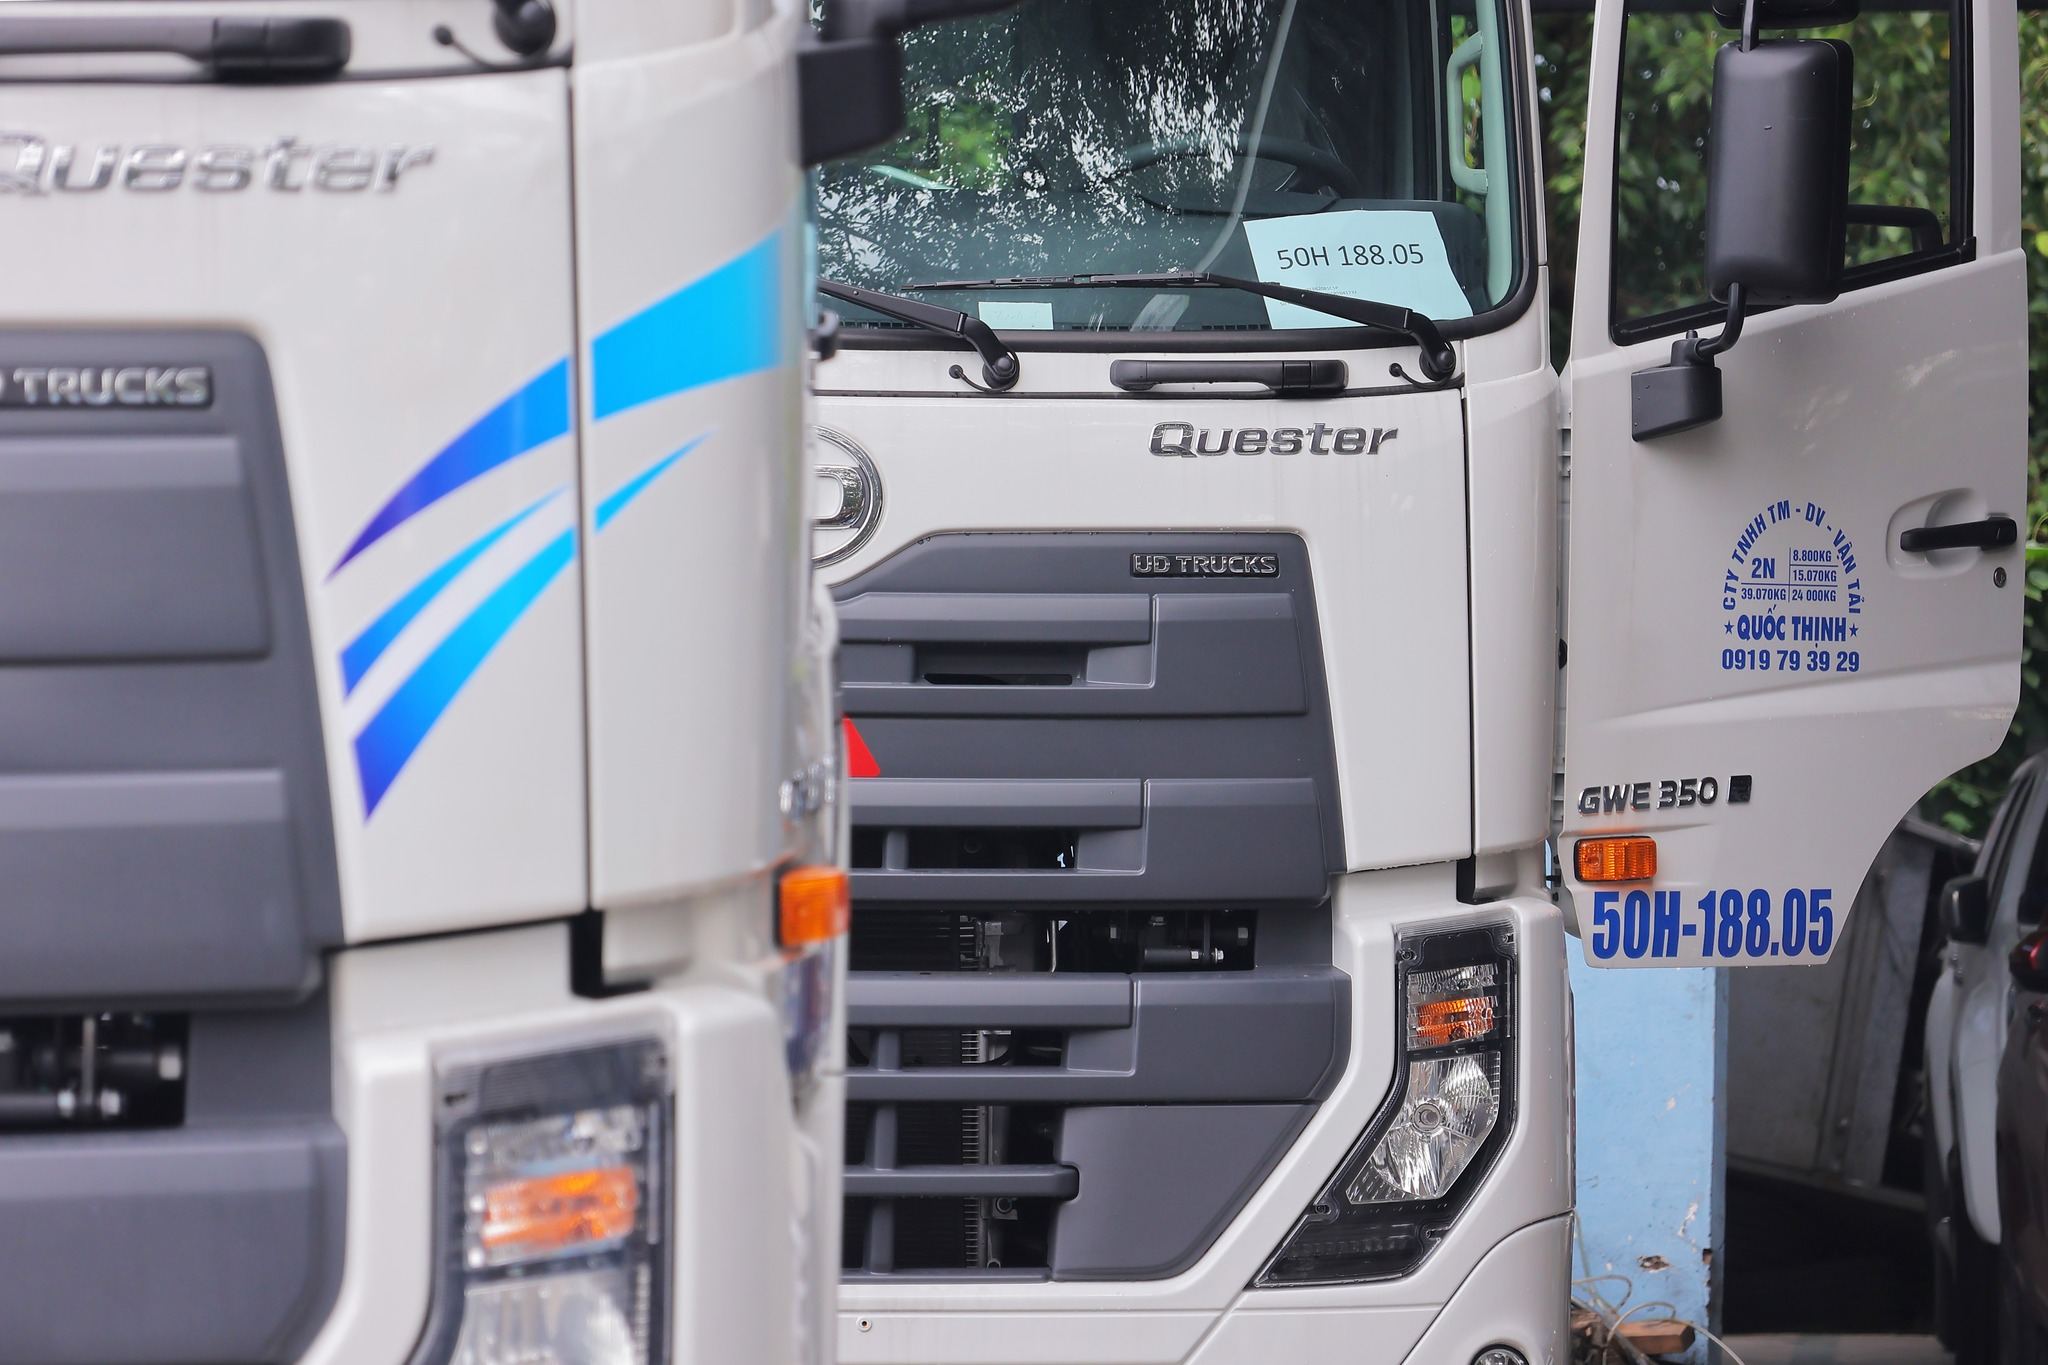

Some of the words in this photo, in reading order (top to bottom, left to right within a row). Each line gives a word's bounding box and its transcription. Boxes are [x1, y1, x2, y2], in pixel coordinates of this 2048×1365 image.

[1277, 246, 1330, 270] 50H
[1338, 243, 1425, 267] 188.05
[13, 367, 208, 404] TRUCKS
[1148, 421, 1399, 458] Quester
[1133, 553, 1171, 574] UD
[1175, 555, 1277, 575] TRUCKS
[1722, 568, 1740, 611] CTY
[1731, 513, 1767, 564] TNHH
[1767, 500, 1791, 524] TM
[1805, 502, 1826, 527] DV
[1833, 529, 1857, 575] VẬN
[1751, 557, 1776, 579] 2N
[1793, 550, 1832, 562] 8.800KG
[1793, 570, 1837, 582] 15.070KG
[1741, 588, 1787, 600] 39.070KG
[1737, 604, 1786, 642] QUỐC
[1791, 616, 1847, 648] THỊNH
[1722, 648, 1771, 670] 0919
[1776, 650, 1800, 671] 79
[1806, 651, 1831, 672] 39
[1836, 651, 1860, 672] 29
[1578, 781, 1652, 815] GWE
[1656, 776, 1718, 810] 350
[1592, 888, 1834, 960] 50H-188.05
